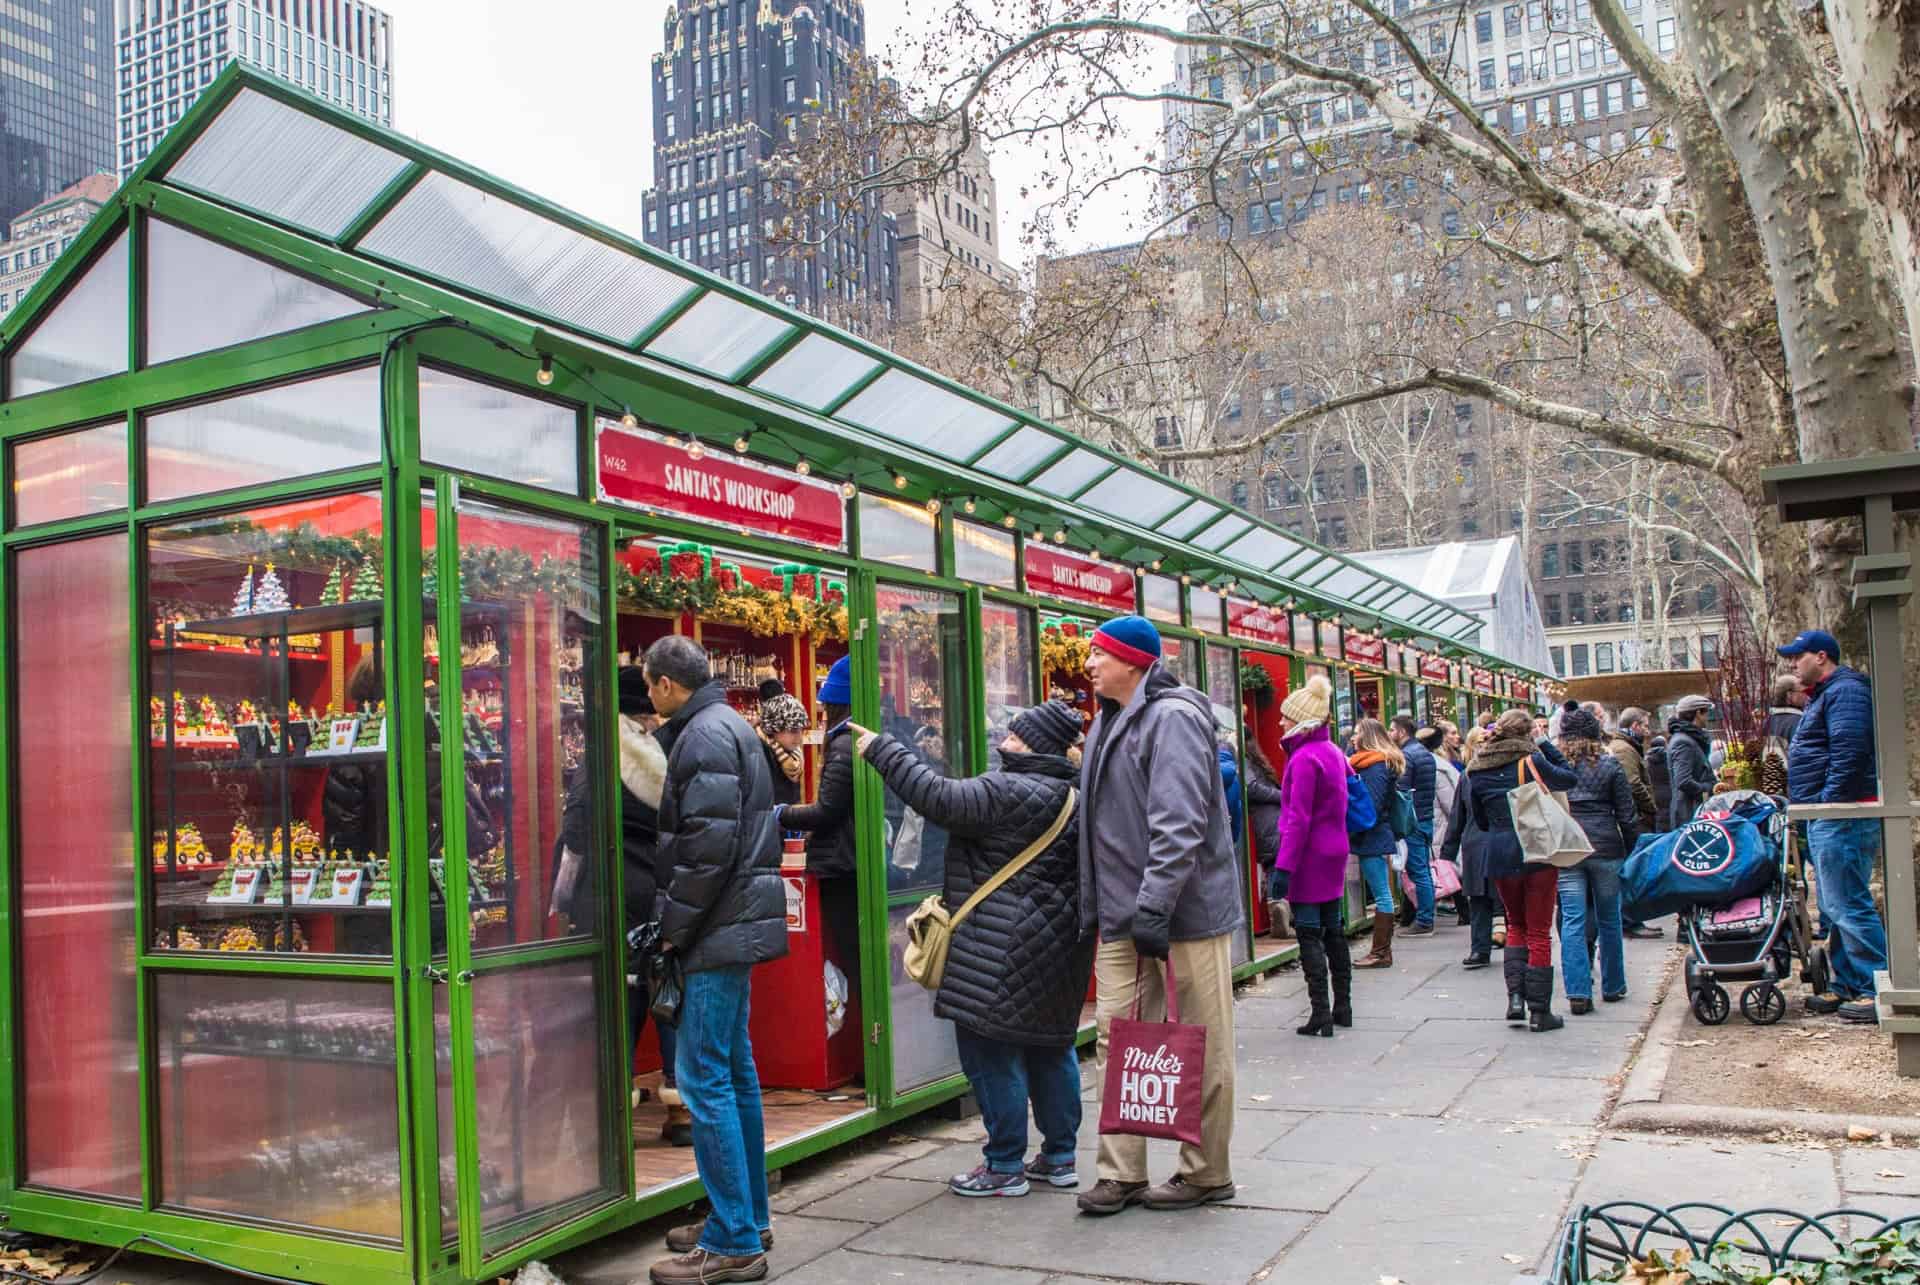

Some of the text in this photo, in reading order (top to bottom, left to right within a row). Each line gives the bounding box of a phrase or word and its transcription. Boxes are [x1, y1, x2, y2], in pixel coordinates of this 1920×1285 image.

[604, 454, 627, 471] W42
[664, 463, 795, 520] SANTA'S WORKSHOP
[1685, 823, 1723, 839] WINTER
[1684, 859, 1710, 869] CLUB
[1124, 1044, 1184, 1073] Mike's
[1120, 1070, 1181, 1106] HOT
[1119, 1101, 1178, 1125] HONEY
